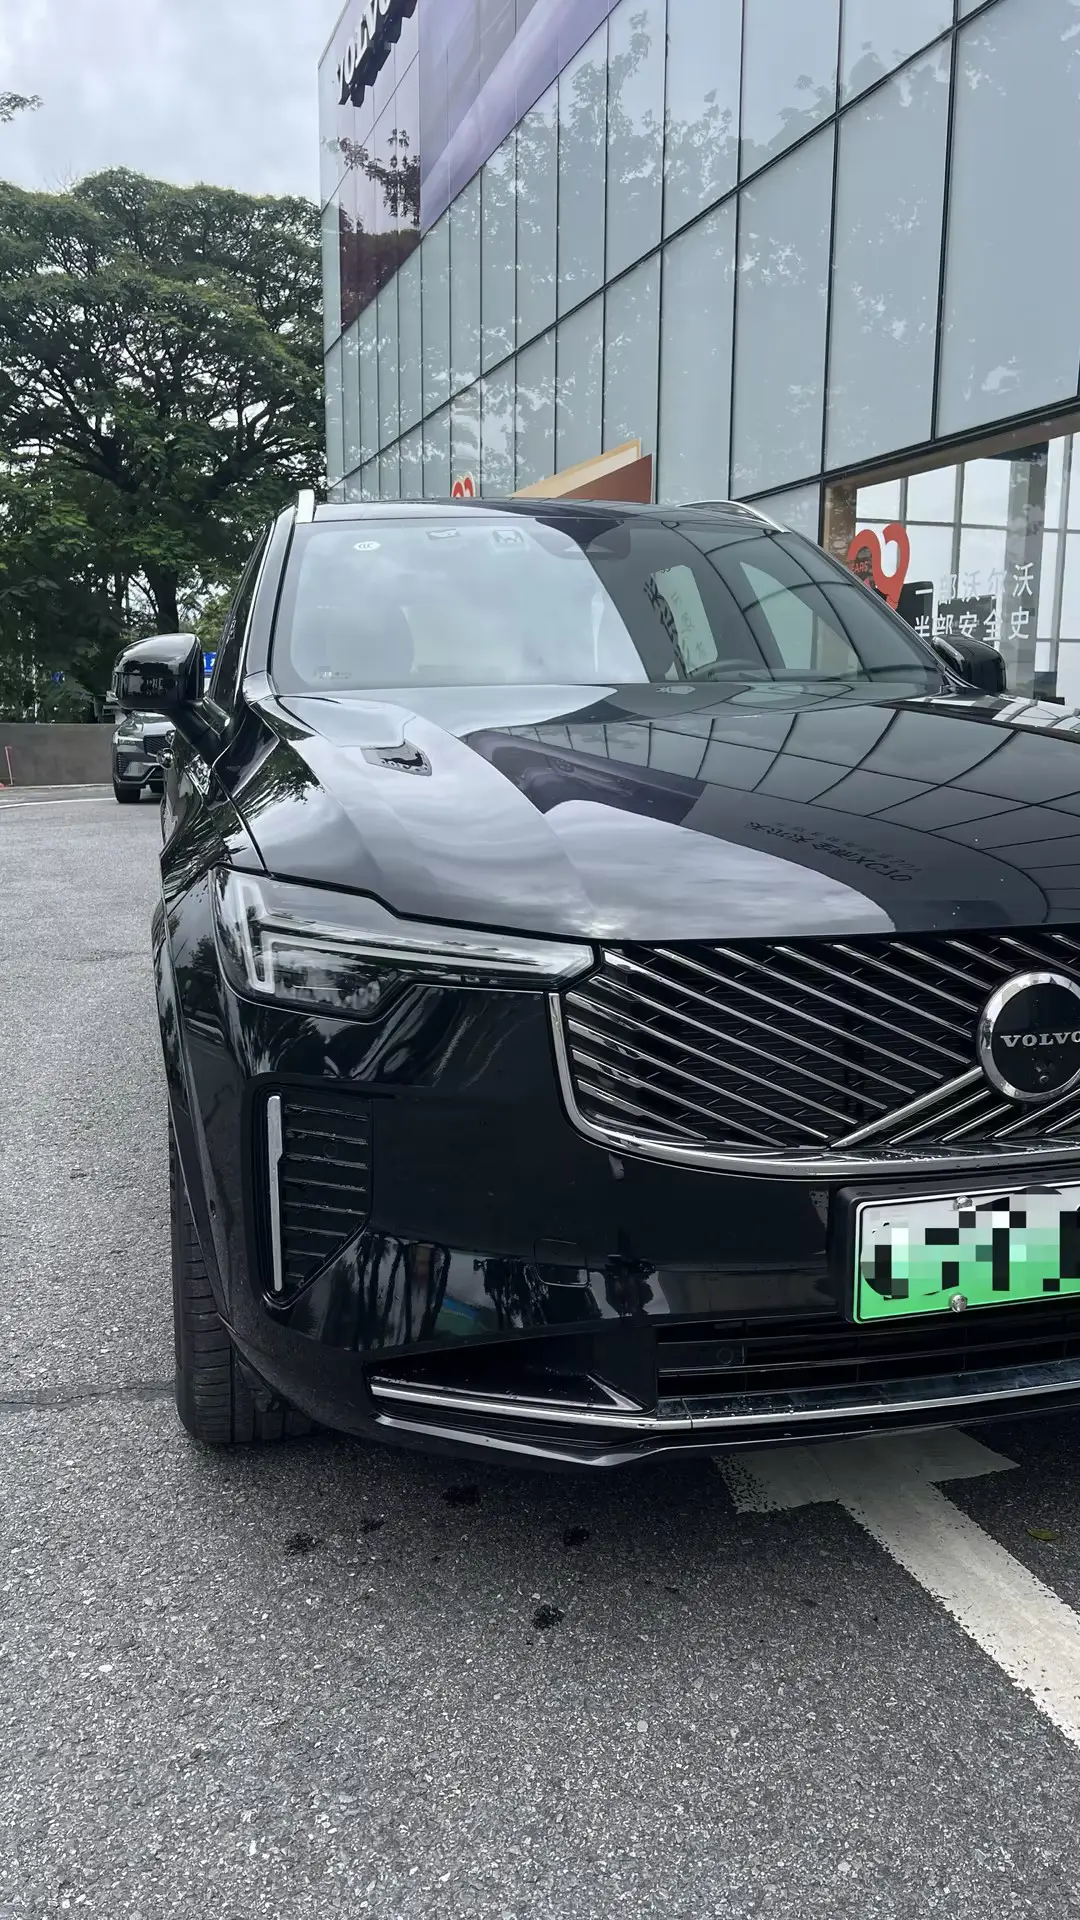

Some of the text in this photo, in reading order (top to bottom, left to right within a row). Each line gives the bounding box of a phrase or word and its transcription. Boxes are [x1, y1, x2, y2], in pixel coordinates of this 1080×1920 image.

[915, 562, 1034, 604] 一部沃尔沃
[914, 606, 1029, 641] 半部安全史
[1000, 1031, 1080, 1047] VOLVO
